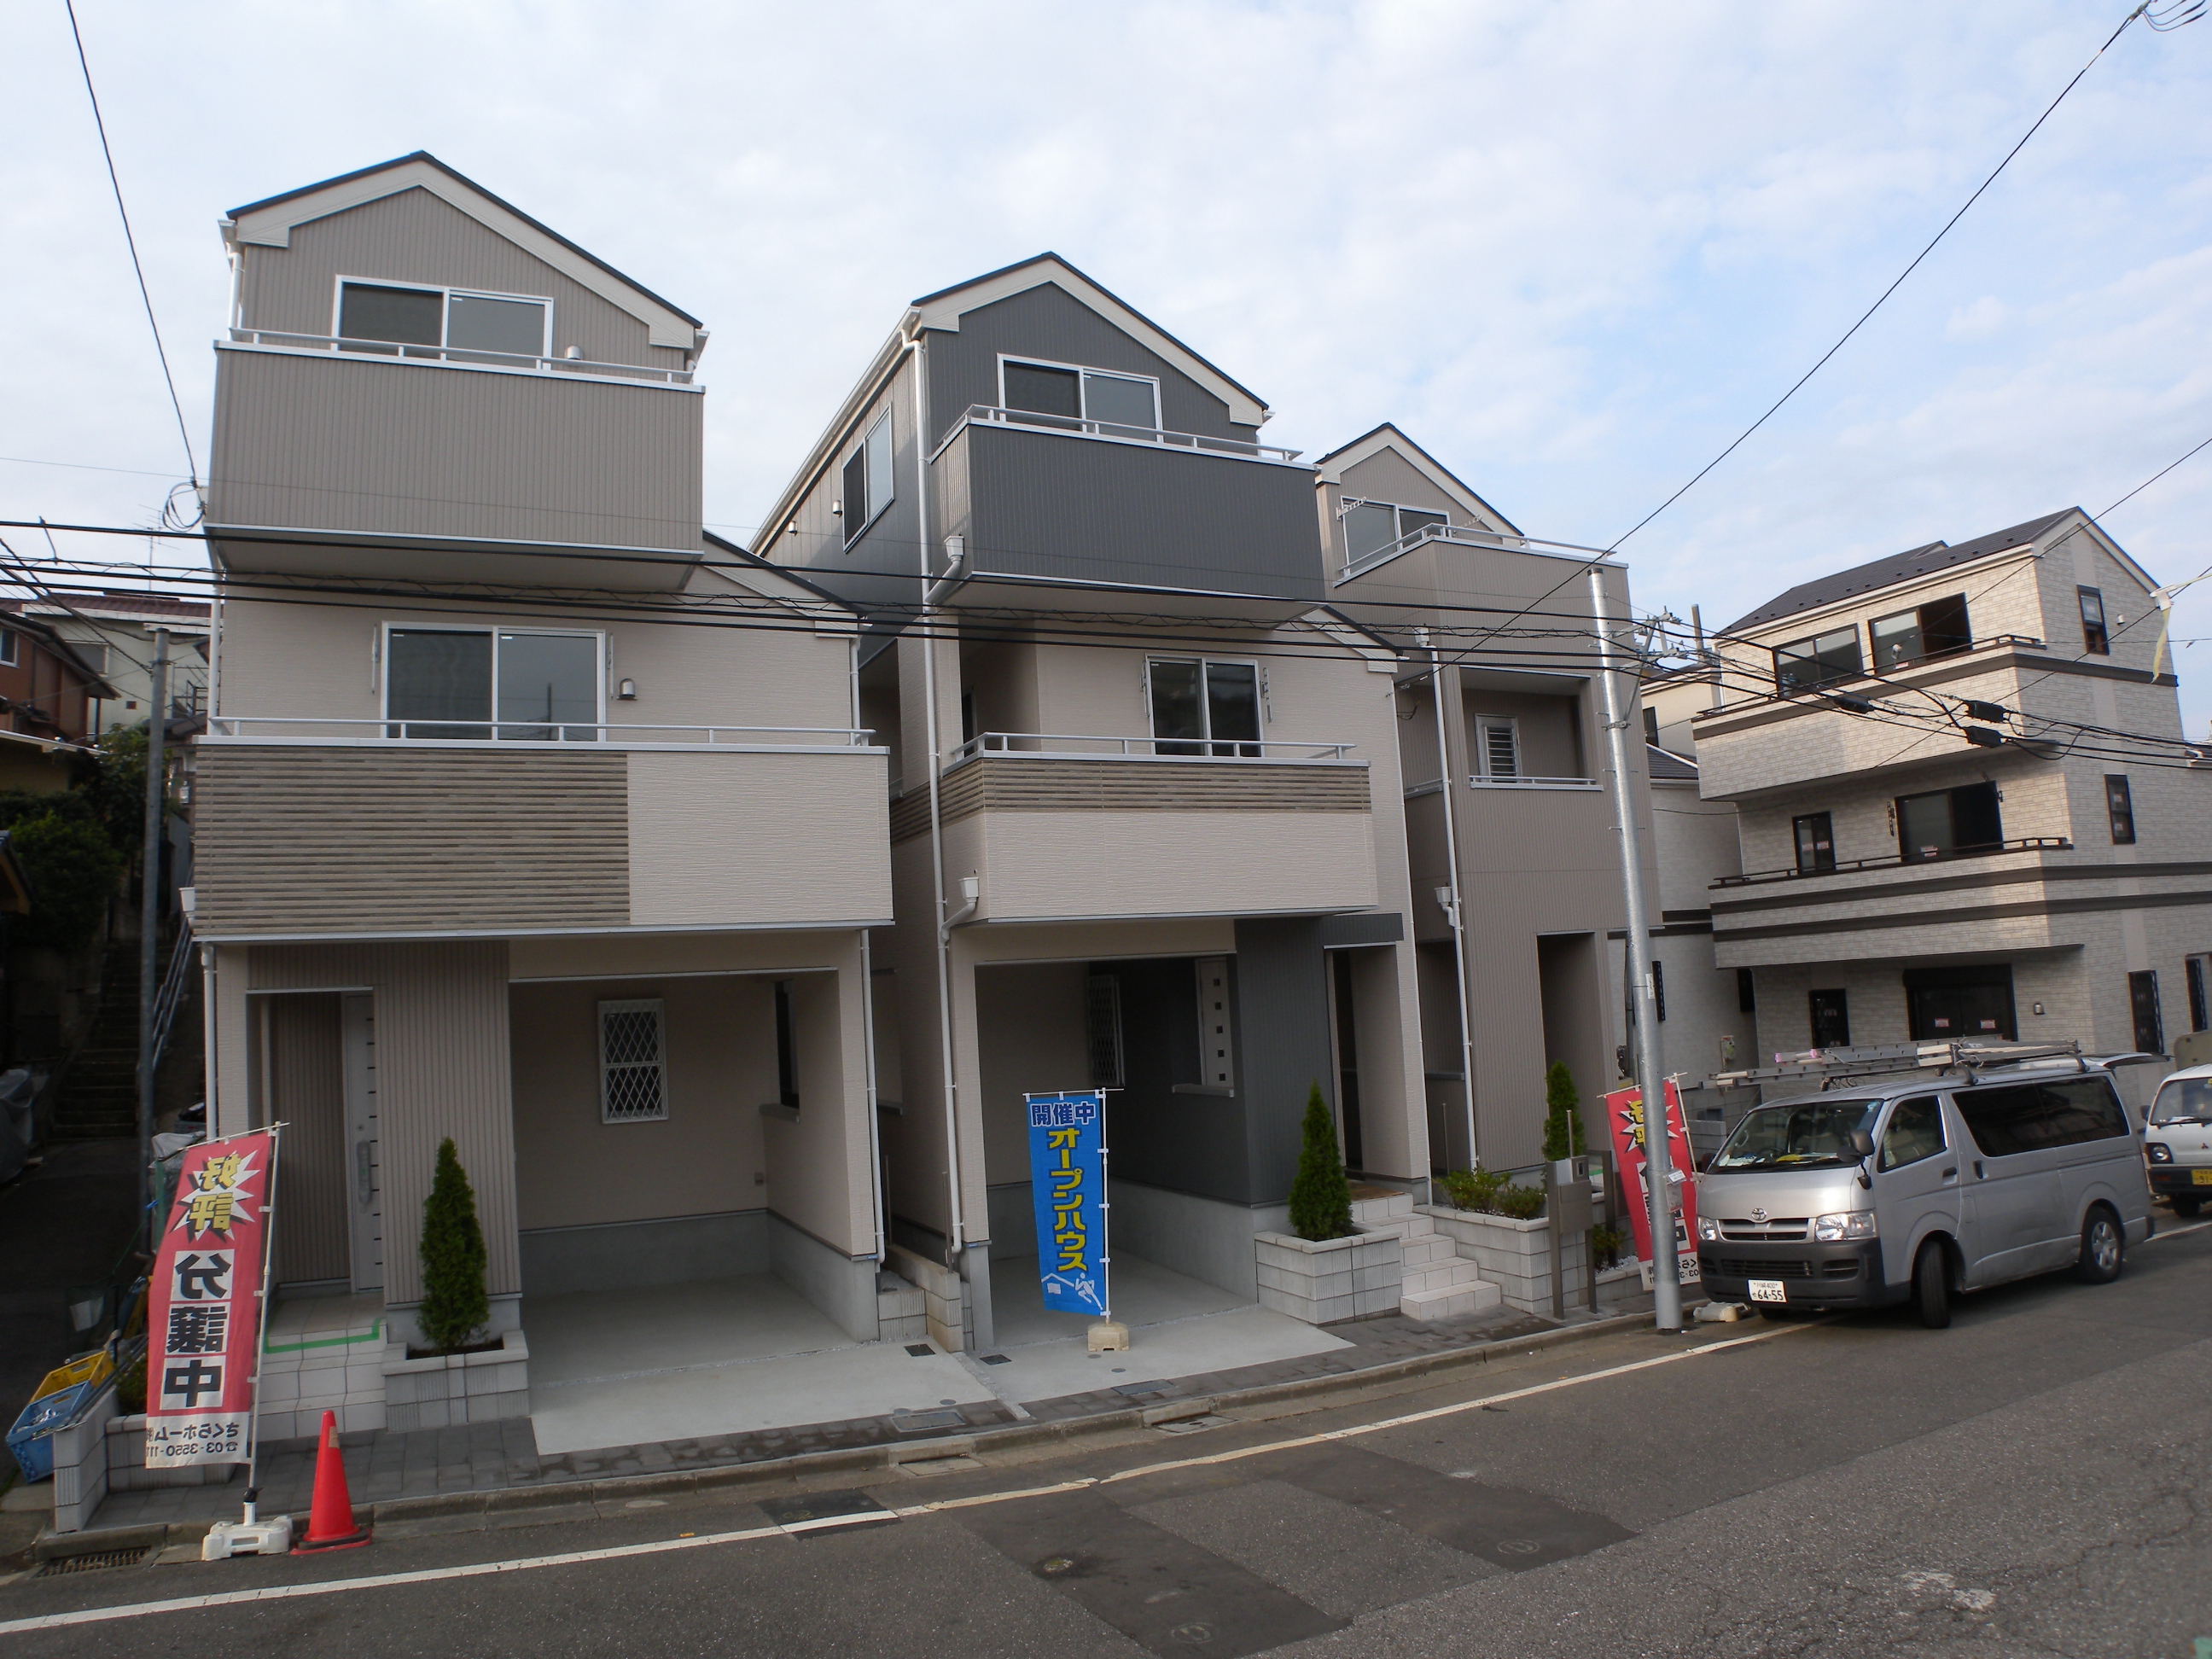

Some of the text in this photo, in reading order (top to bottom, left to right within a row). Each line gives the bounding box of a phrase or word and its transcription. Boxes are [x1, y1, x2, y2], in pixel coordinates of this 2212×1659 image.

[1030, 1101, 1096, 1126] 開催中
[1048, 1127, 1087, 1272] オープンハウス
